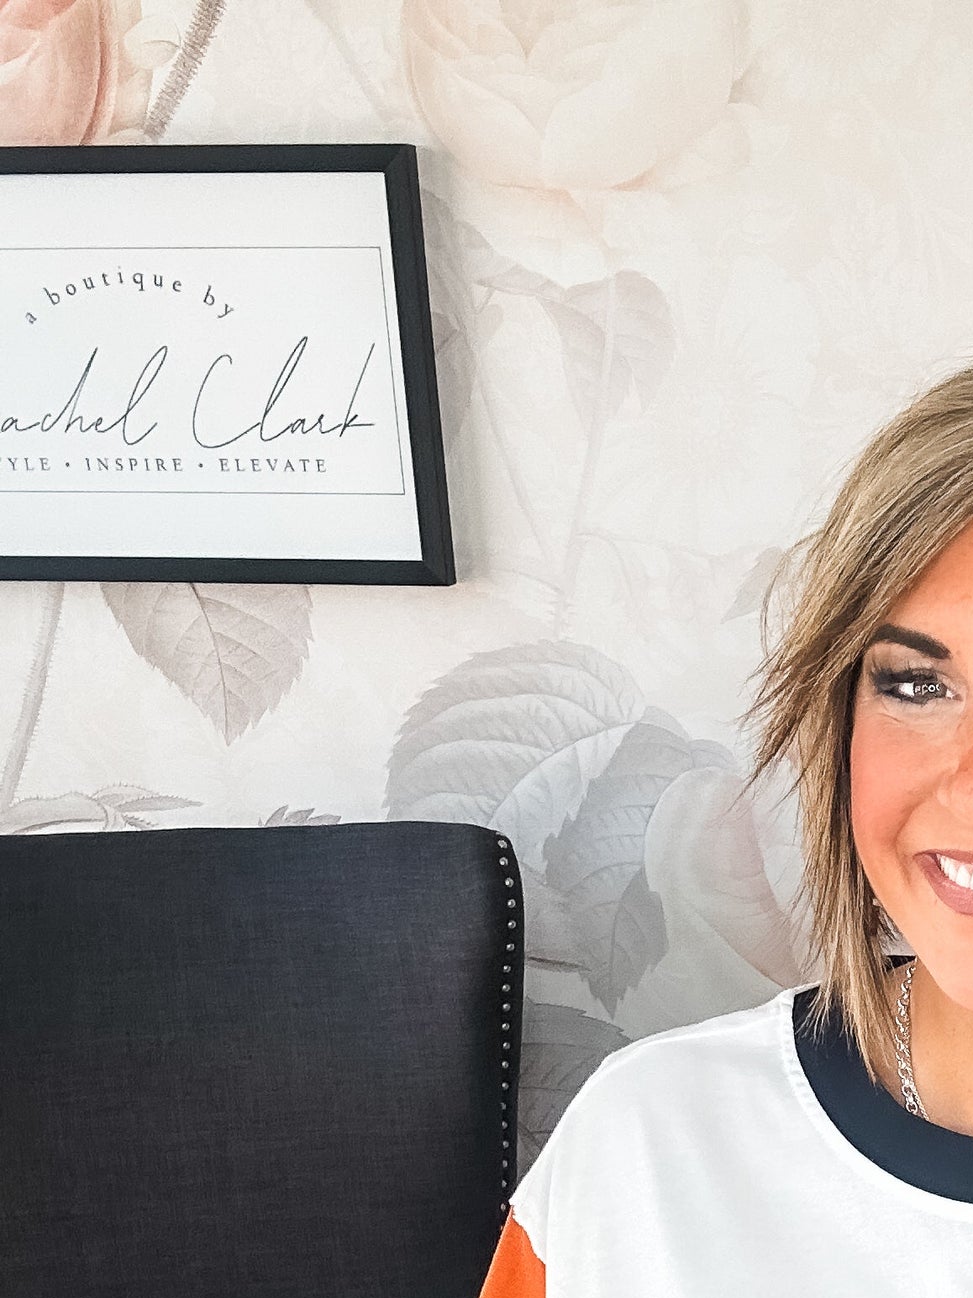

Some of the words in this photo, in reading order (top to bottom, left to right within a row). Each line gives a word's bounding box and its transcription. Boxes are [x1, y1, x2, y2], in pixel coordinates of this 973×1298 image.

[25, 311, 37, 324] a
[43, 266, 182, 305] boutique
[203, 285, 234, 318] by
[0, 345, 168, 445] achel
[193, 336, 375, 448] Clark
[0, 456, 51, 471] YLE
[85, 457, 184, 472] INSPIRE
[219, 458, 328, 473] ELEVATE
